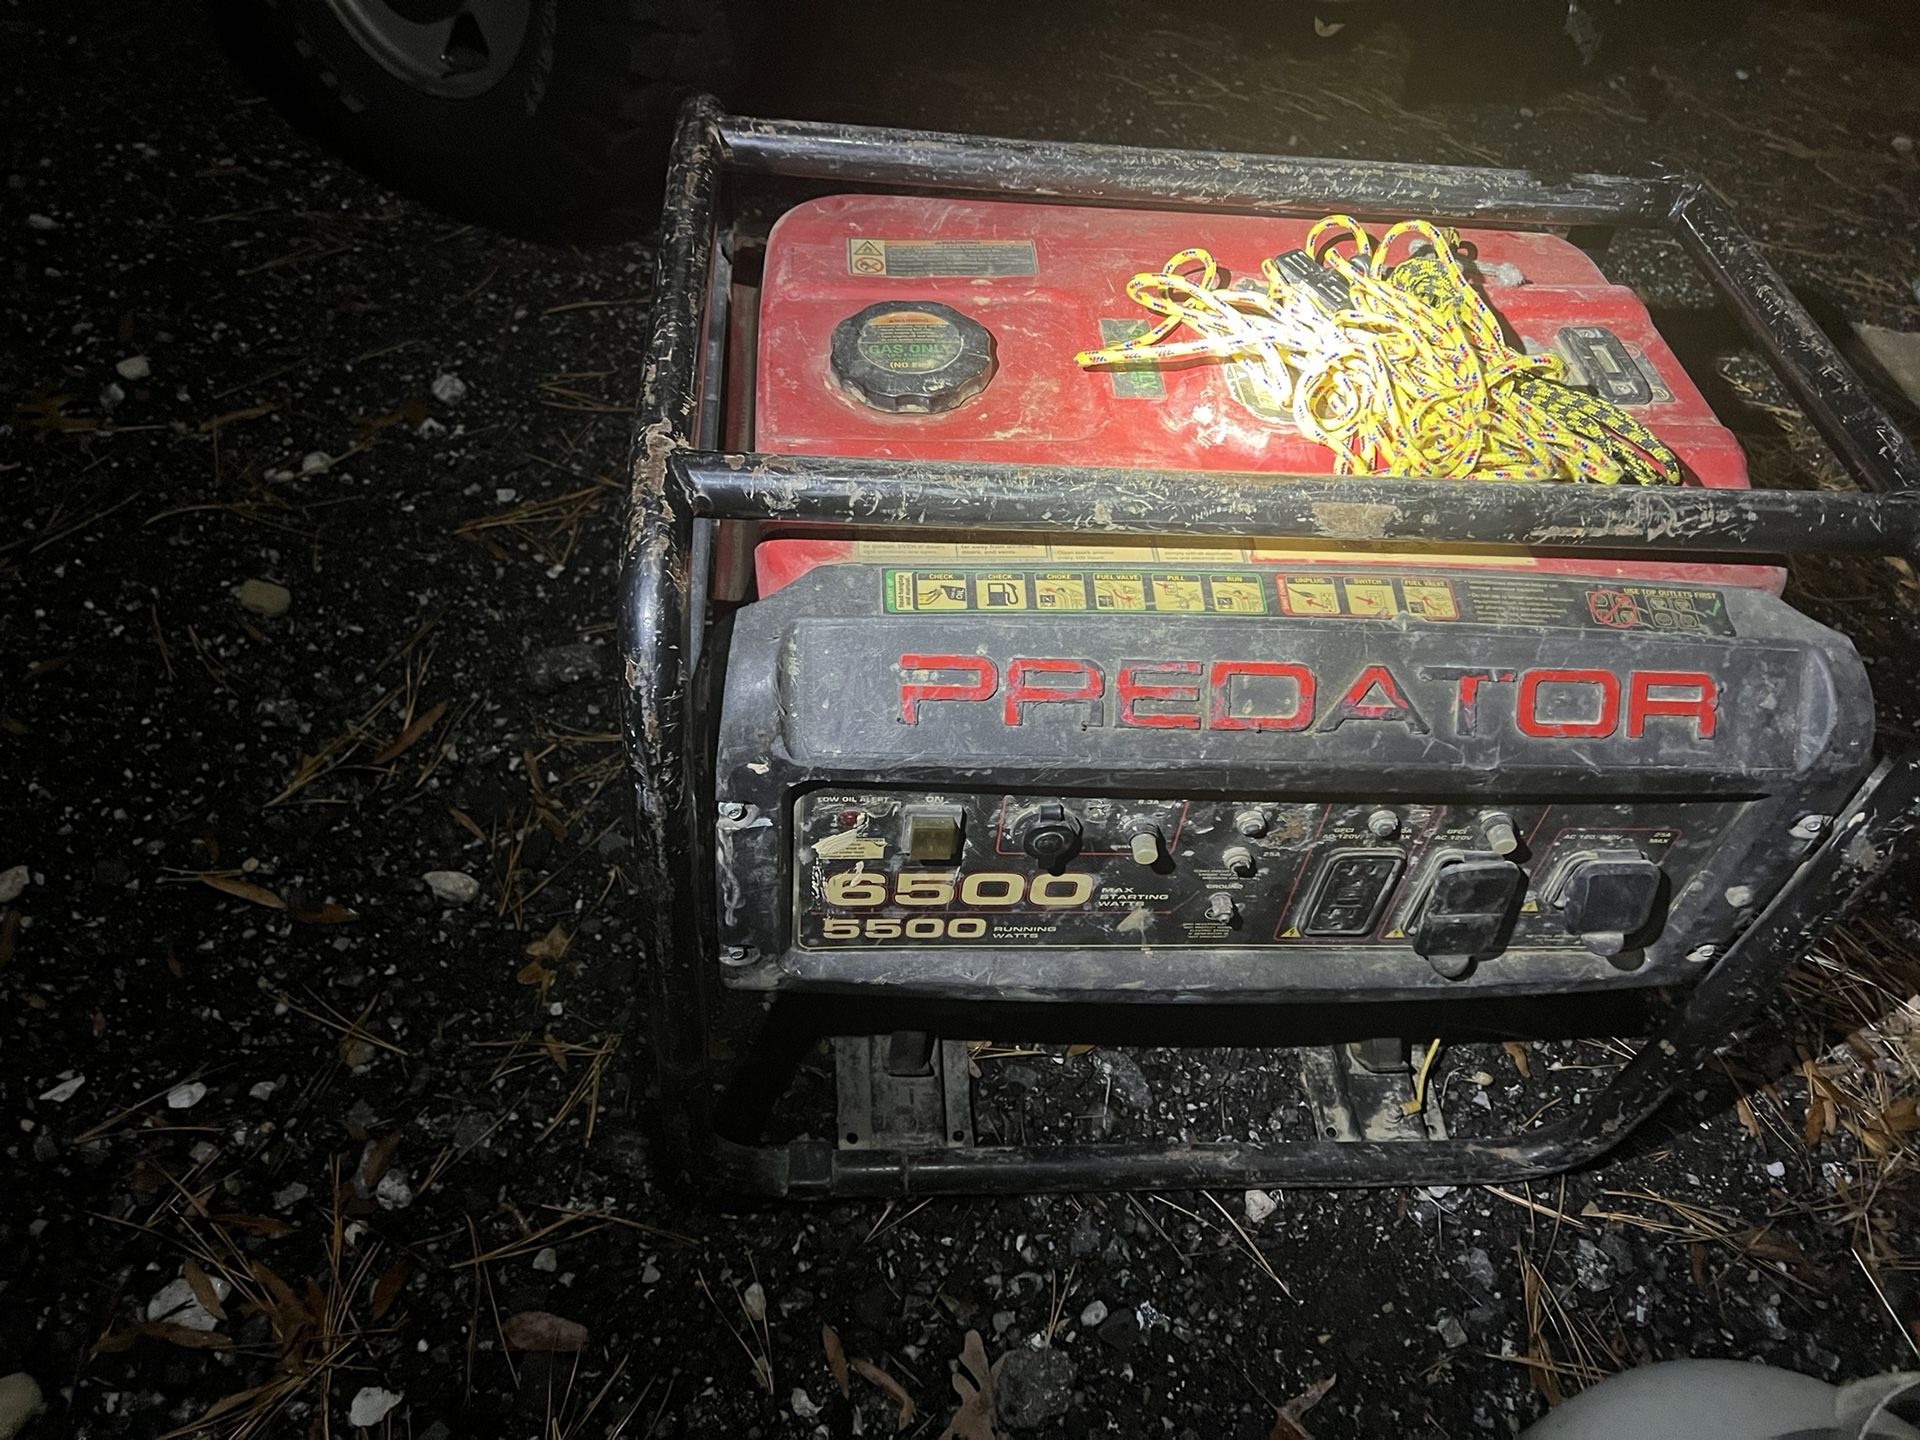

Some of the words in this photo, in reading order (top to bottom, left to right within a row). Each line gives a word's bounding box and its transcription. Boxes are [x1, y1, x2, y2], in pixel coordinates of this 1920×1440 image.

[868, 344, 903, 353] GAS
[908, 344, 952, 354] ONLY
[1623, 587, 1641, 595] USE
[1641, 588, 1657, 596] TOP
[1658, 589, 1693, 598] OUTLETS
[1694, 591, 1717, 600] FIRST
[896, 654, 1722, 740] PREDATOR
[825, 872, 1095, 906] 6500
[822, 917, 988, 940] 5500
